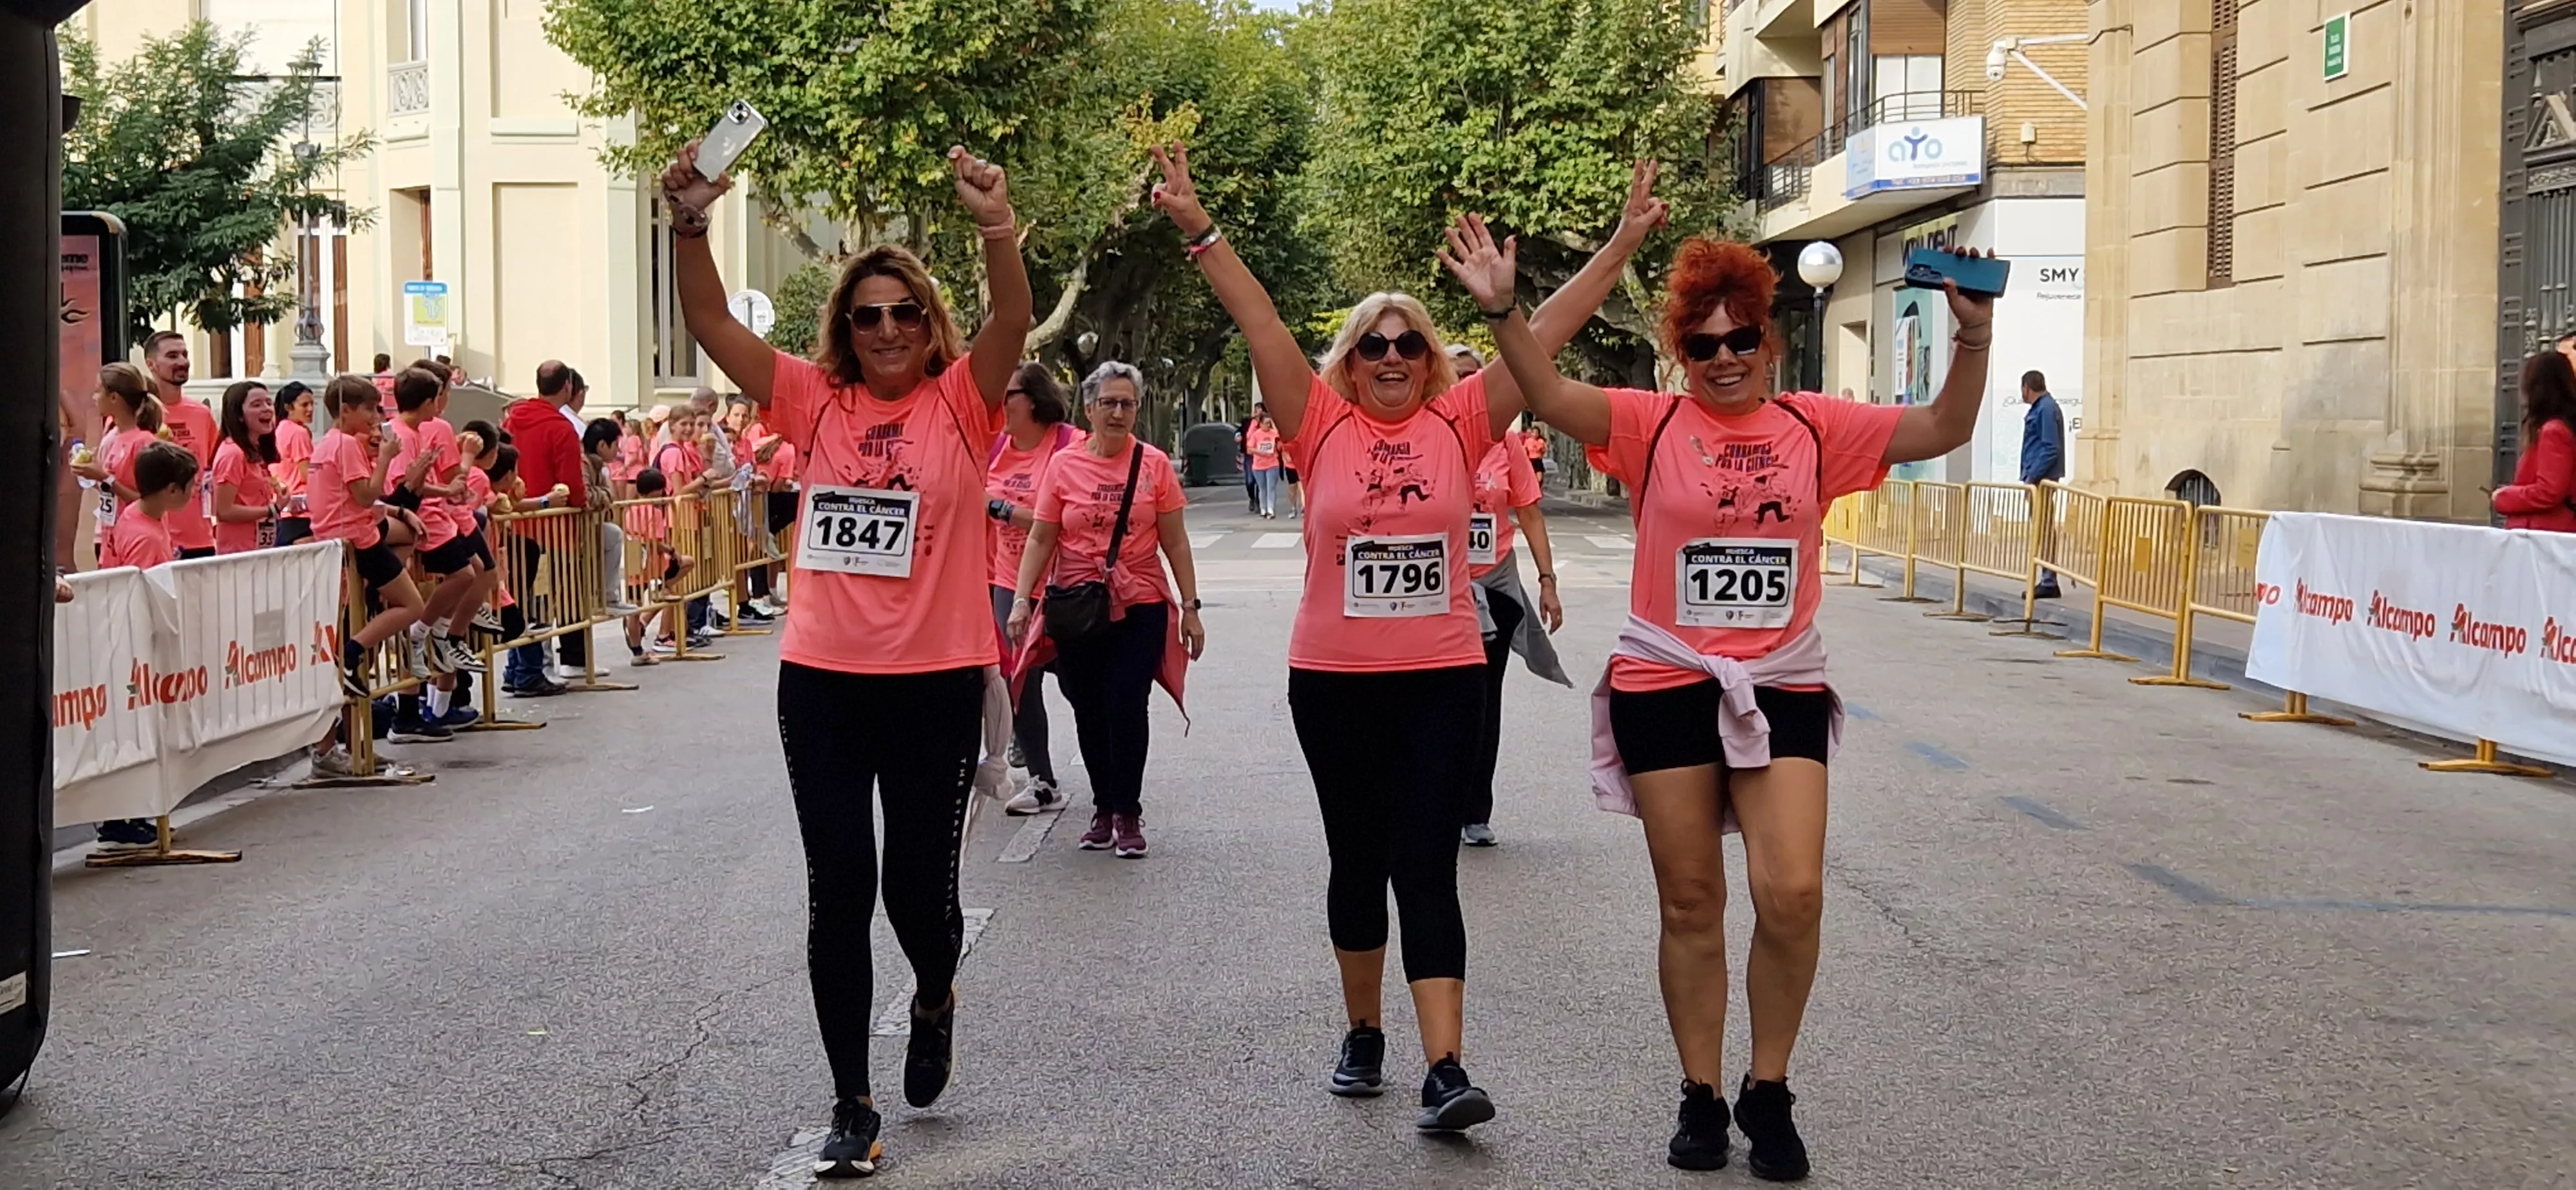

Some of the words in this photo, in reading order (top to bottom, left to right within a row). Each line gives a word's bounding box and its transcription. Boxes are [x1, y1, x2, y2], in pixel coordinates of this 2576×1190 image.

[2040, 268, 2079, 283] SMY
[818, 502, 855, 512] CONTRA
[857, 504, 867, 513] EL
[869, 505, 905, 515] CÁNCER
[816, 516, 905, 551] 1847
[1358, 551, 1395, 560] CONTRA
[1691, 555, 1732, 563] CONTRA
[1735, 555, 1746, 563] EL
[1748, 554, 1787, 565] CÁNCER
[1358, 562, 1441, 594] 1796
[1690, 569, 1785, 602] 1205
[2367, 589, 2436, 642] Alcampo
[2449, 603, 2526, 659] Alcampo
[225, 641, 296, 690] Alcampo
